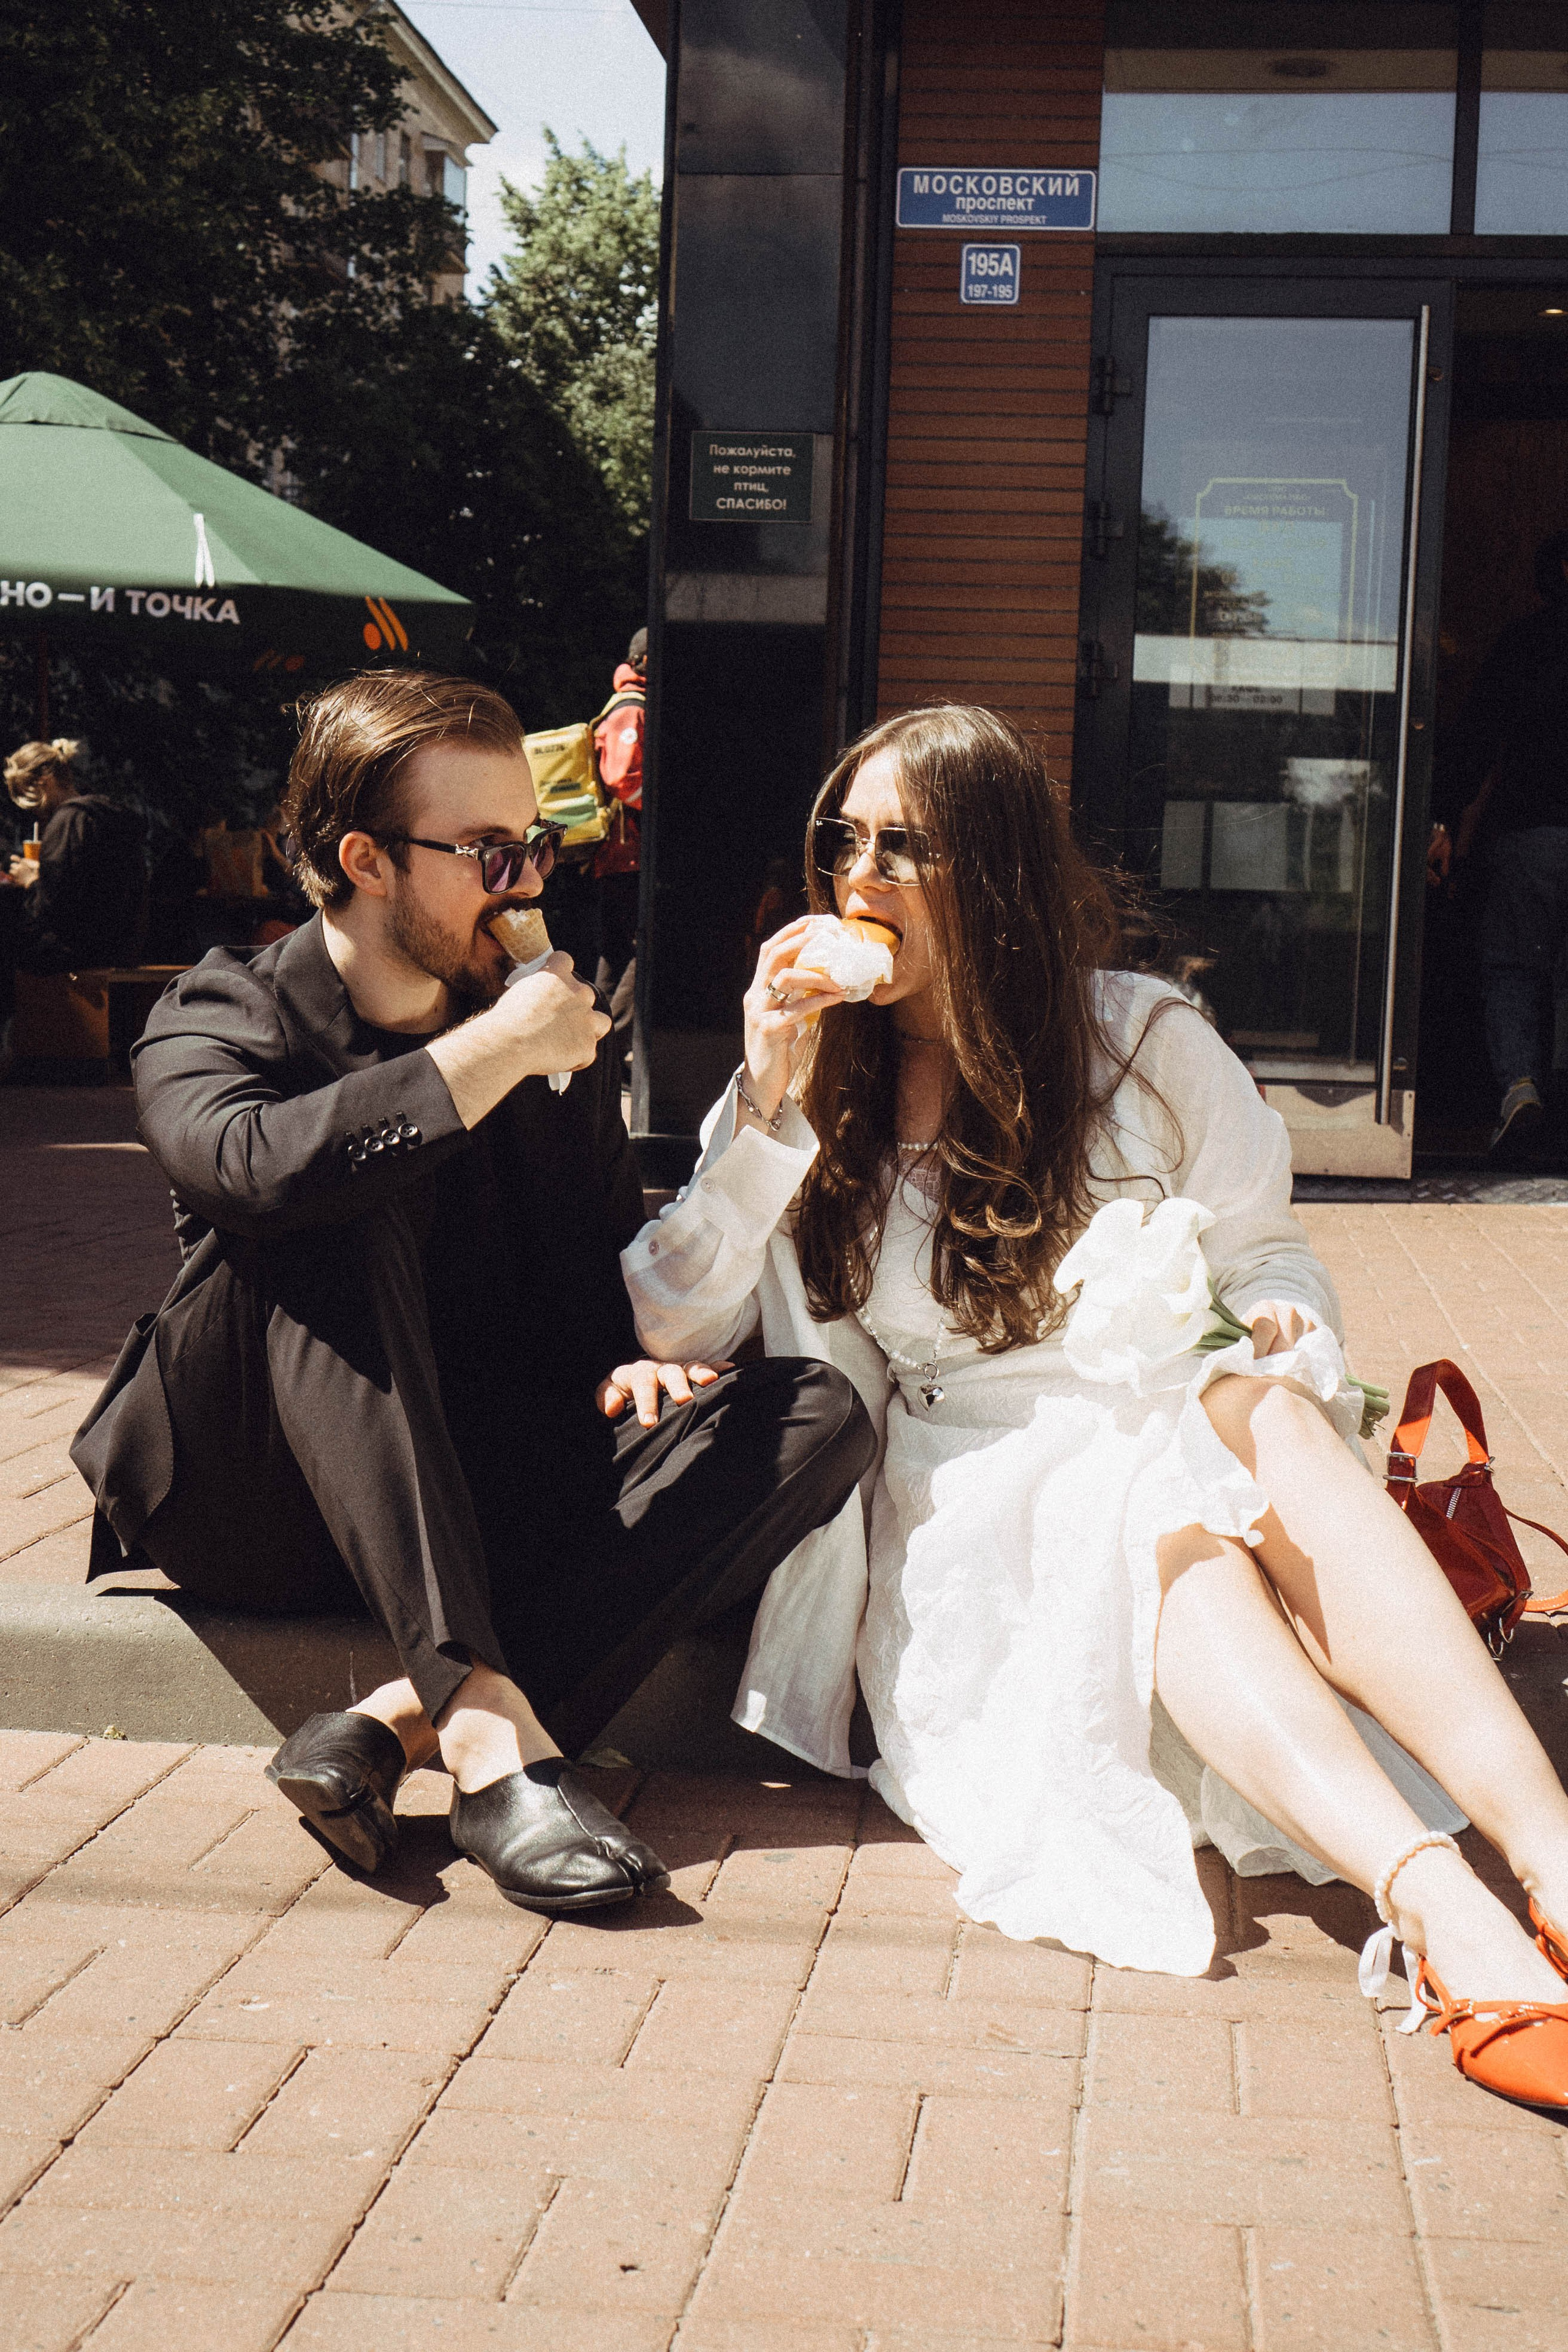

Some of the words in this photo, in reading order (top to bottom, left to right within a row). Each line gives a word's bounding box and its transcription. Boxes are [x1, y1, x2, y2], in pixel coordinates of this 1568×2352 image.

[913, 175, 1080, 197] МОСКОВСКИЙ
[956, 197, 1035, 213] проспект
[1000, 214, 1047, 225] PROSPEKT
[968, 252, 1014, 276] 195А
[968, 284, 1013, 299] 197-195
[709, 444, 796, 458] Пожалуйста,
[714, 465, 731, 474] не
[733, 465, 791, 477] кормите
[715, 497, 787, 510] СПАСИБО!
[125, 590, 241, 624] ТОЧКА
